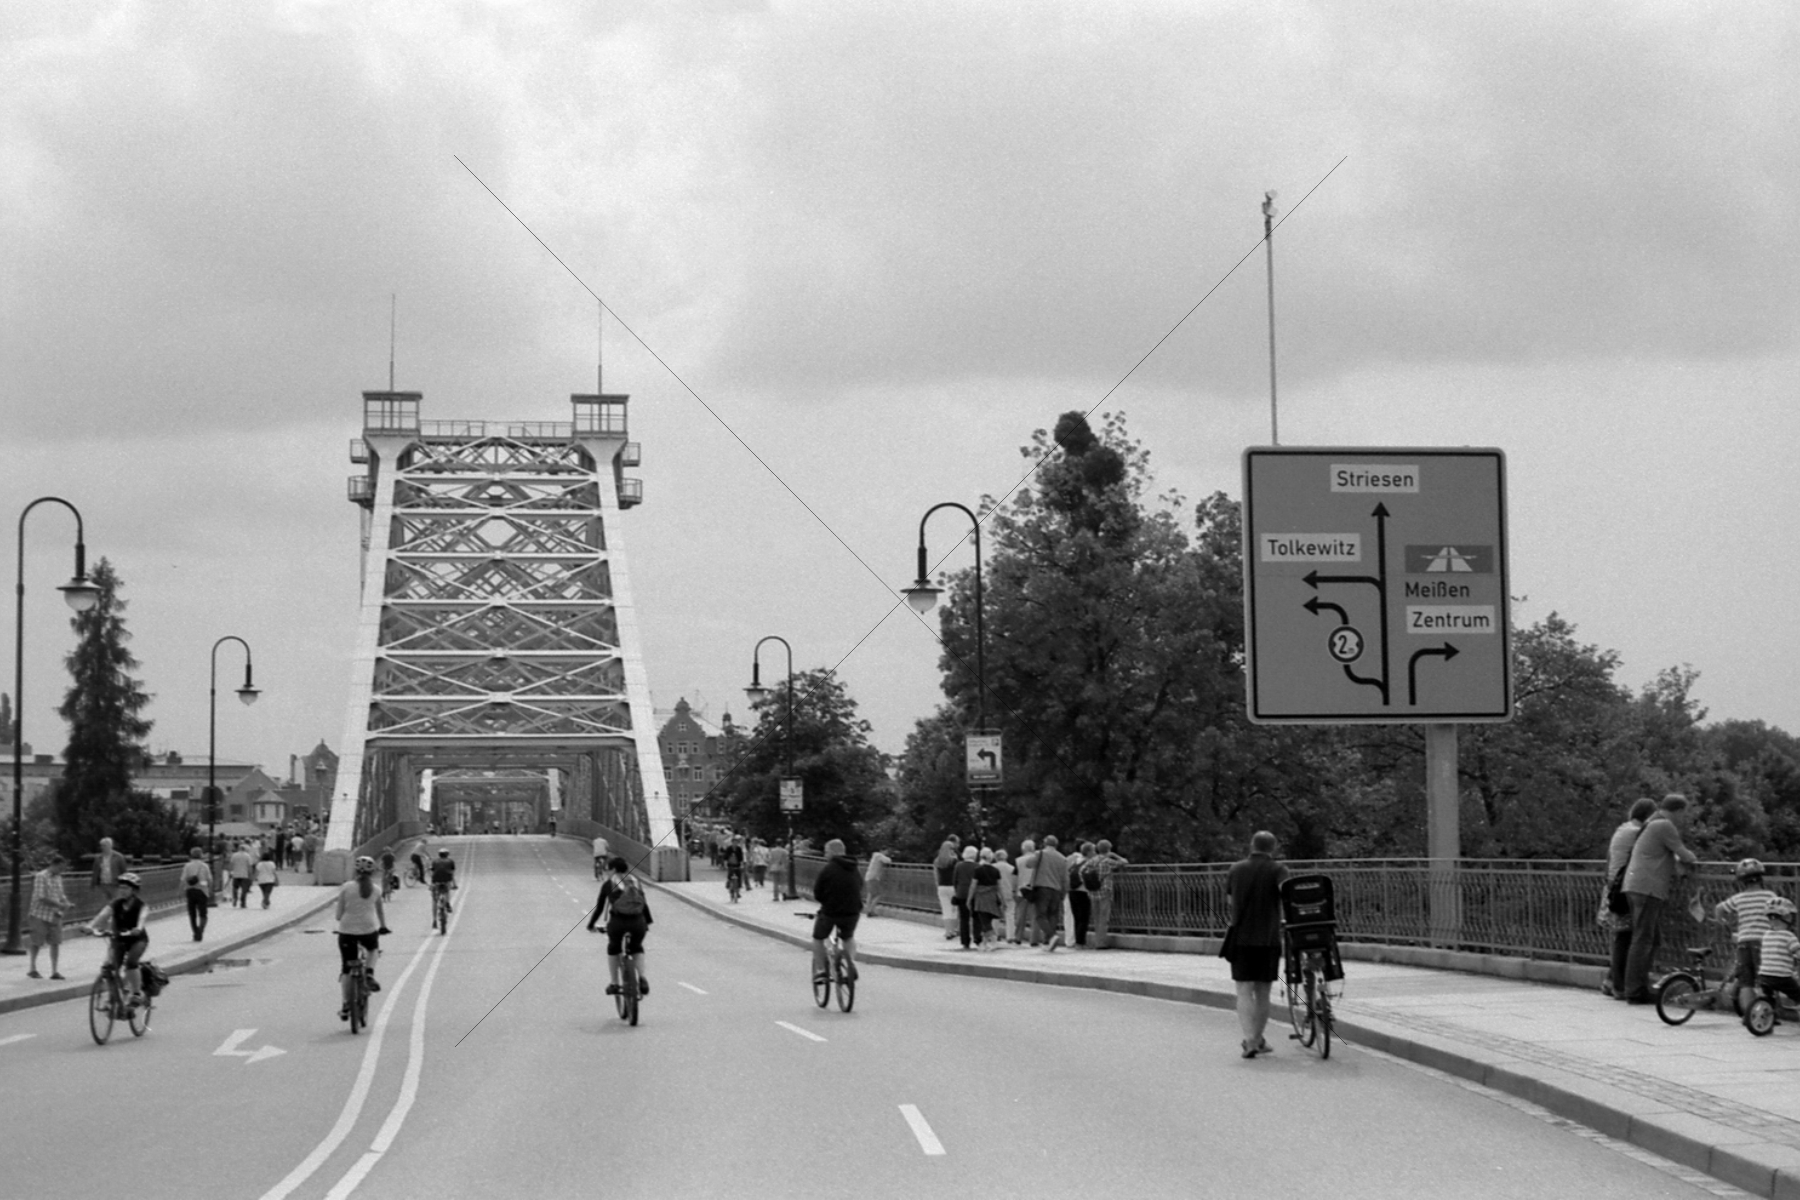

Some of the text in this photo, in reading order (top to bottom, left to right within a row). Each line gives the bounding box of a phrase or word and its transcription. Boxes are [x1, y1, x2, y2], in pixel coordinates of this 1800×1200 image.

[1336, 470, 1414, 488] Striesen
[1267, 539, 1355, 556] Tolkewitz
[1405, 581, 1470, 598] Meißen
[1412, 611, 1490, 628] Zentrum
